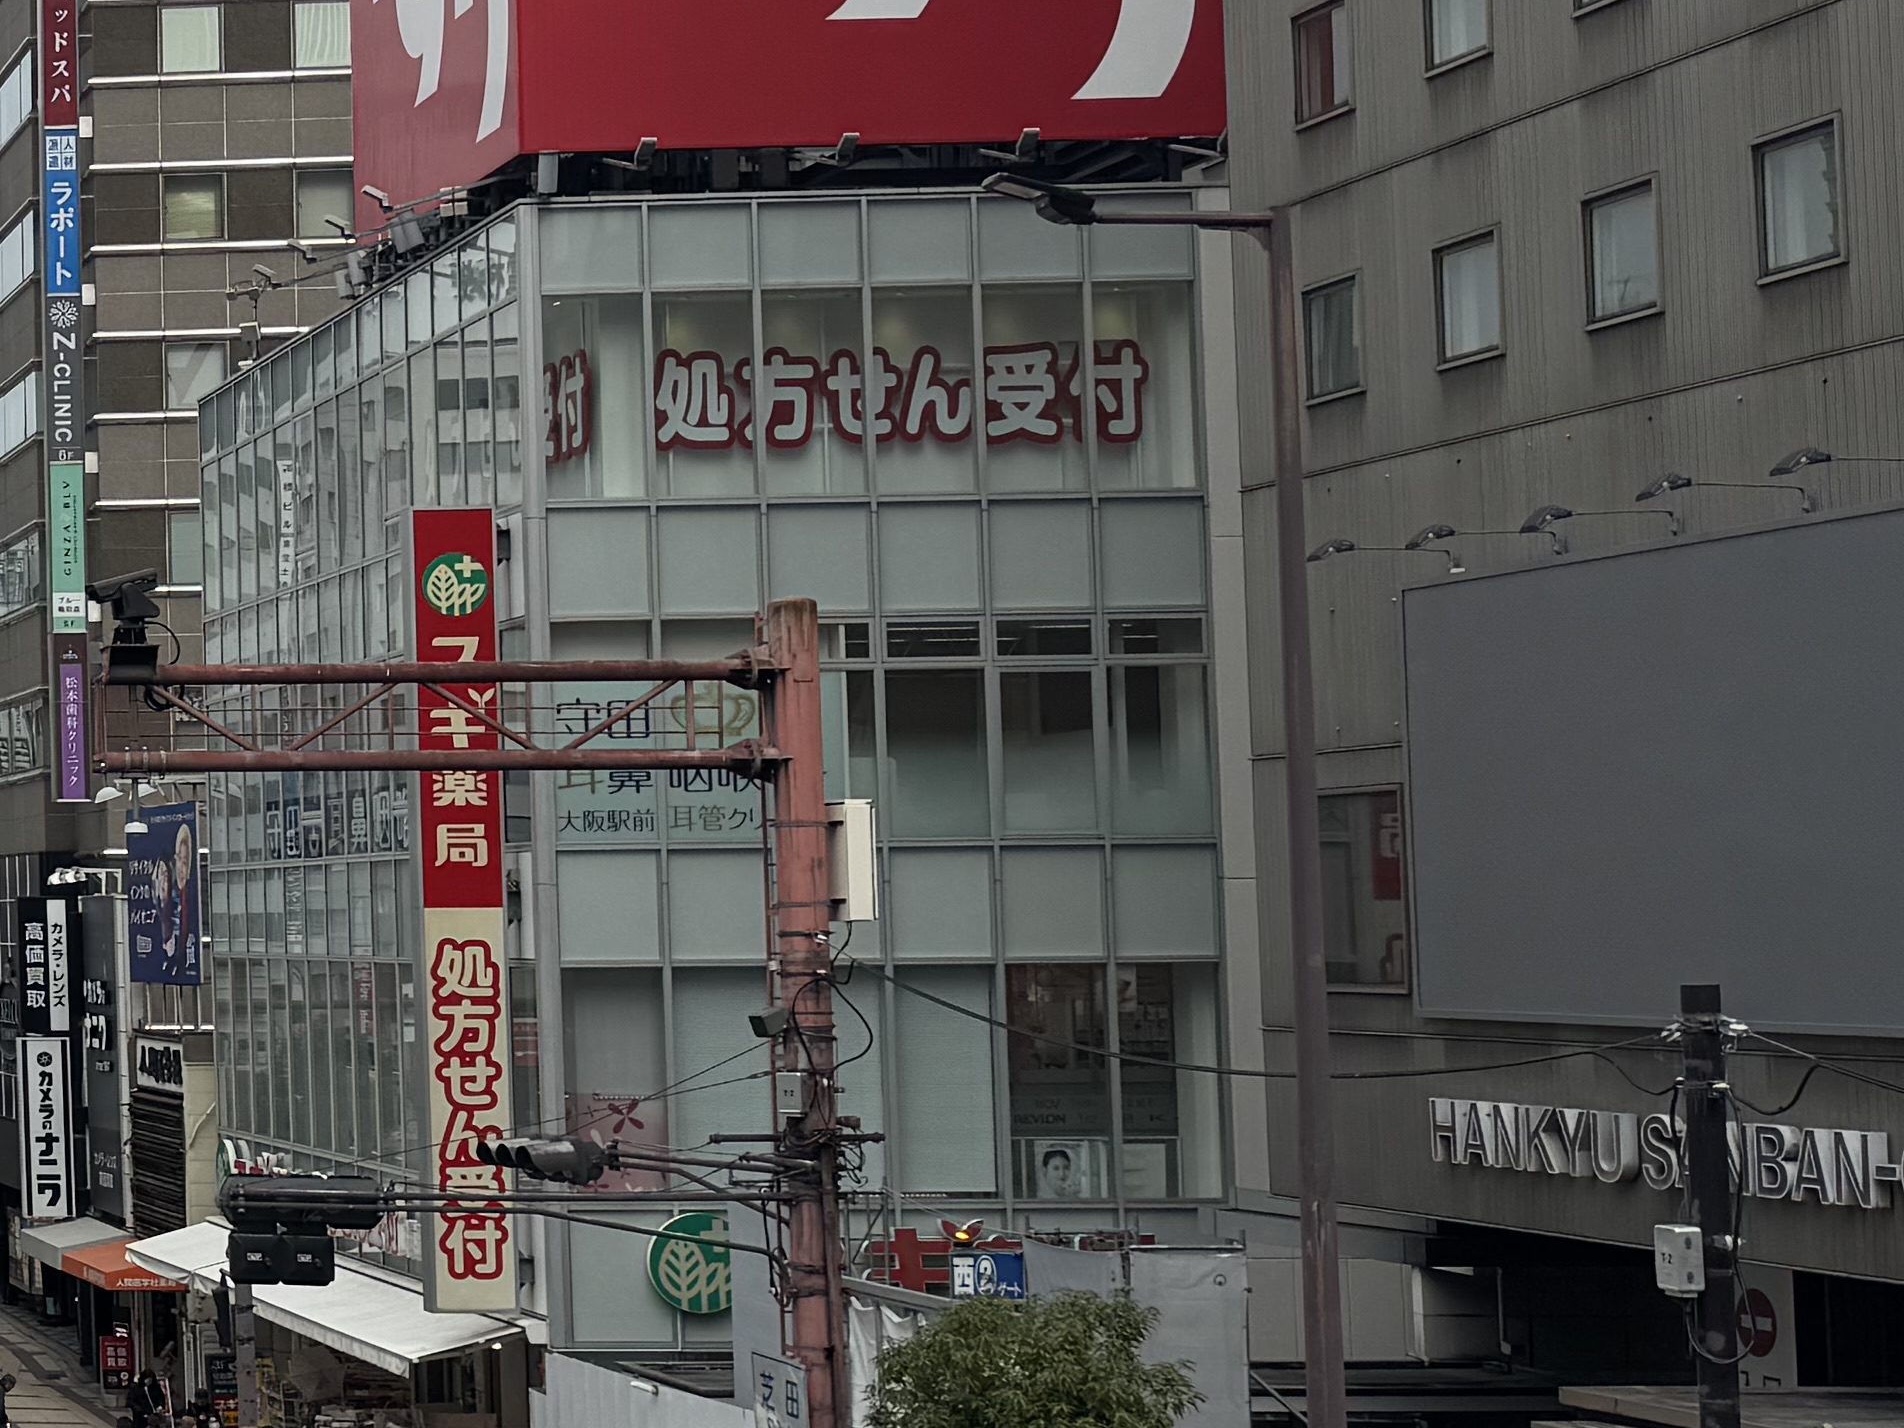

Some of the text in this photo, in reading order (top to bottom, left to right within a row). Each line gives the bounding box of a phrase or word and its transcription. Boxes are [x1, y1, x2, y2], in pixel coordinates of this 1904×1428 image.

[49, 179, 77, 287] ラポート
[52, 332, 74, 442] Z-CLINIC
[653, 339, 1148, 452] 処方せん受付
[557, 808, 656, 833] 大阪駅前
[24, 922, 46, 1009] 高価買取
[50, 922, 67, 1008] カメラ・レンズ
[34, 1070, 62, 1208] カメラのナニワ
[1428, 1097, 1632, 1184] HANKYU
